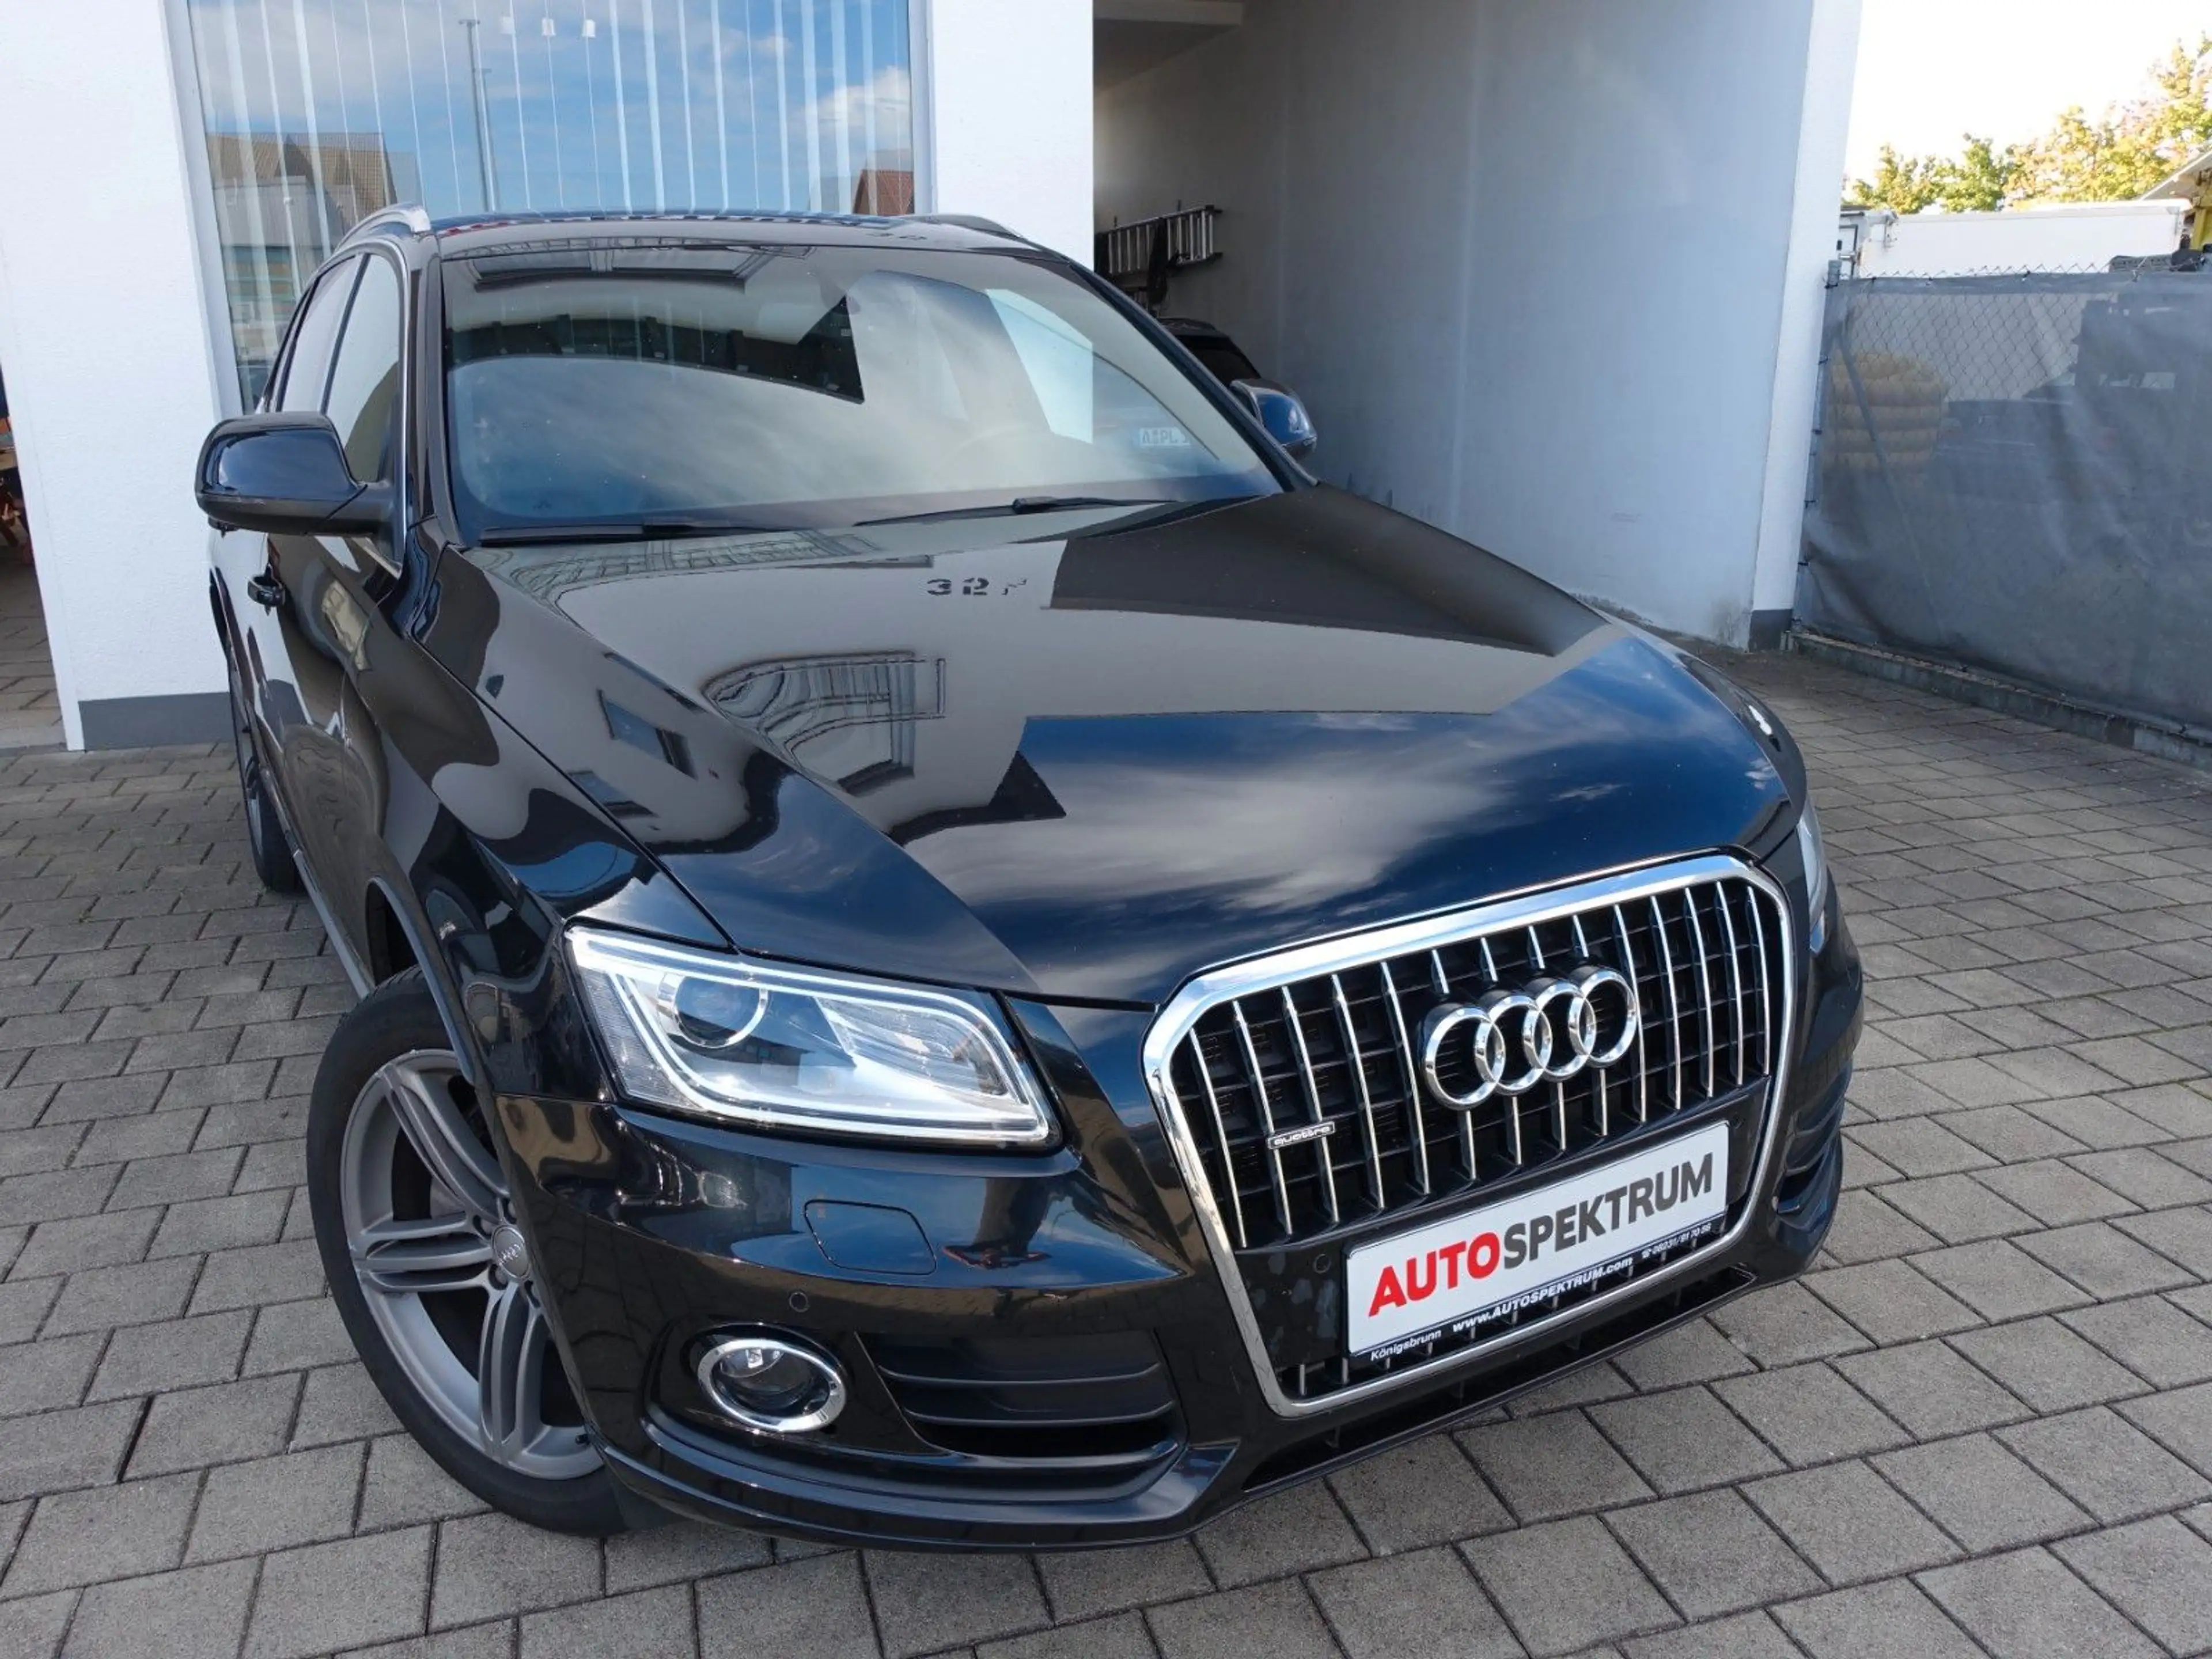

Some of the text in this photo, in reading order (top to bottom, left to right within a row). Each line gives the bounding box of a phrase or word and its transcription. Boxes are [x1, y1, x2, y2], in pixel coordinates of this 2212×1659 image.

[1273, 1126, 1330, 1146] quattro
[1368, 1152, 1713, 1317] AUTOSPEKTRUM
[1370, 1330, 1442, 1361] Königsbrunn
[1452, 1257, 1633, 1332] www.AUTOSPEKTRUM.com
